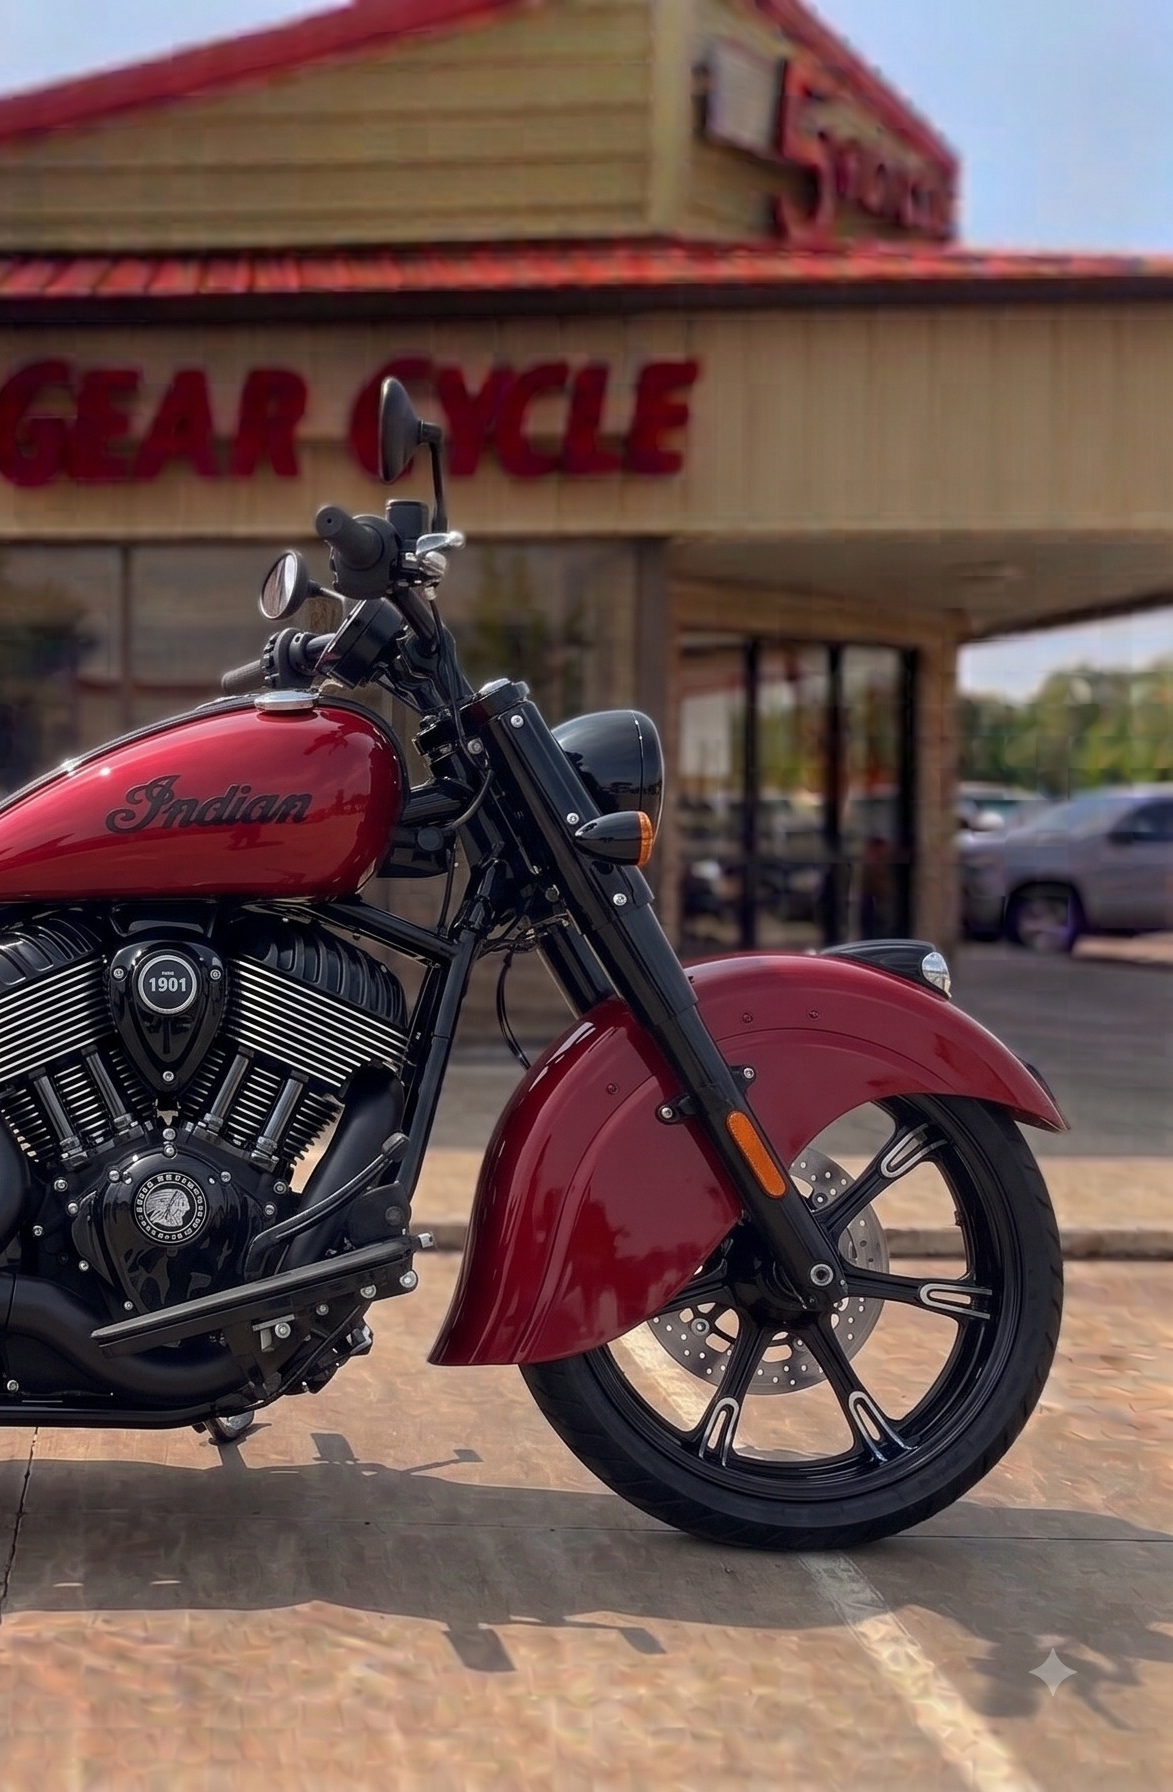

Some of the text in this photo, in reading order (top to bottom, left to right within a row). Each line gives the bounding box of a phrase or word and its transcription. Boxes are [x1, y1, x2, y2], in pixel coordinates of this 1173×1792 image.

[349, 354, 700, 481] CYCLE
[105, 774, 313, 835] Indian
[148, 977, 187, 992] 1901
